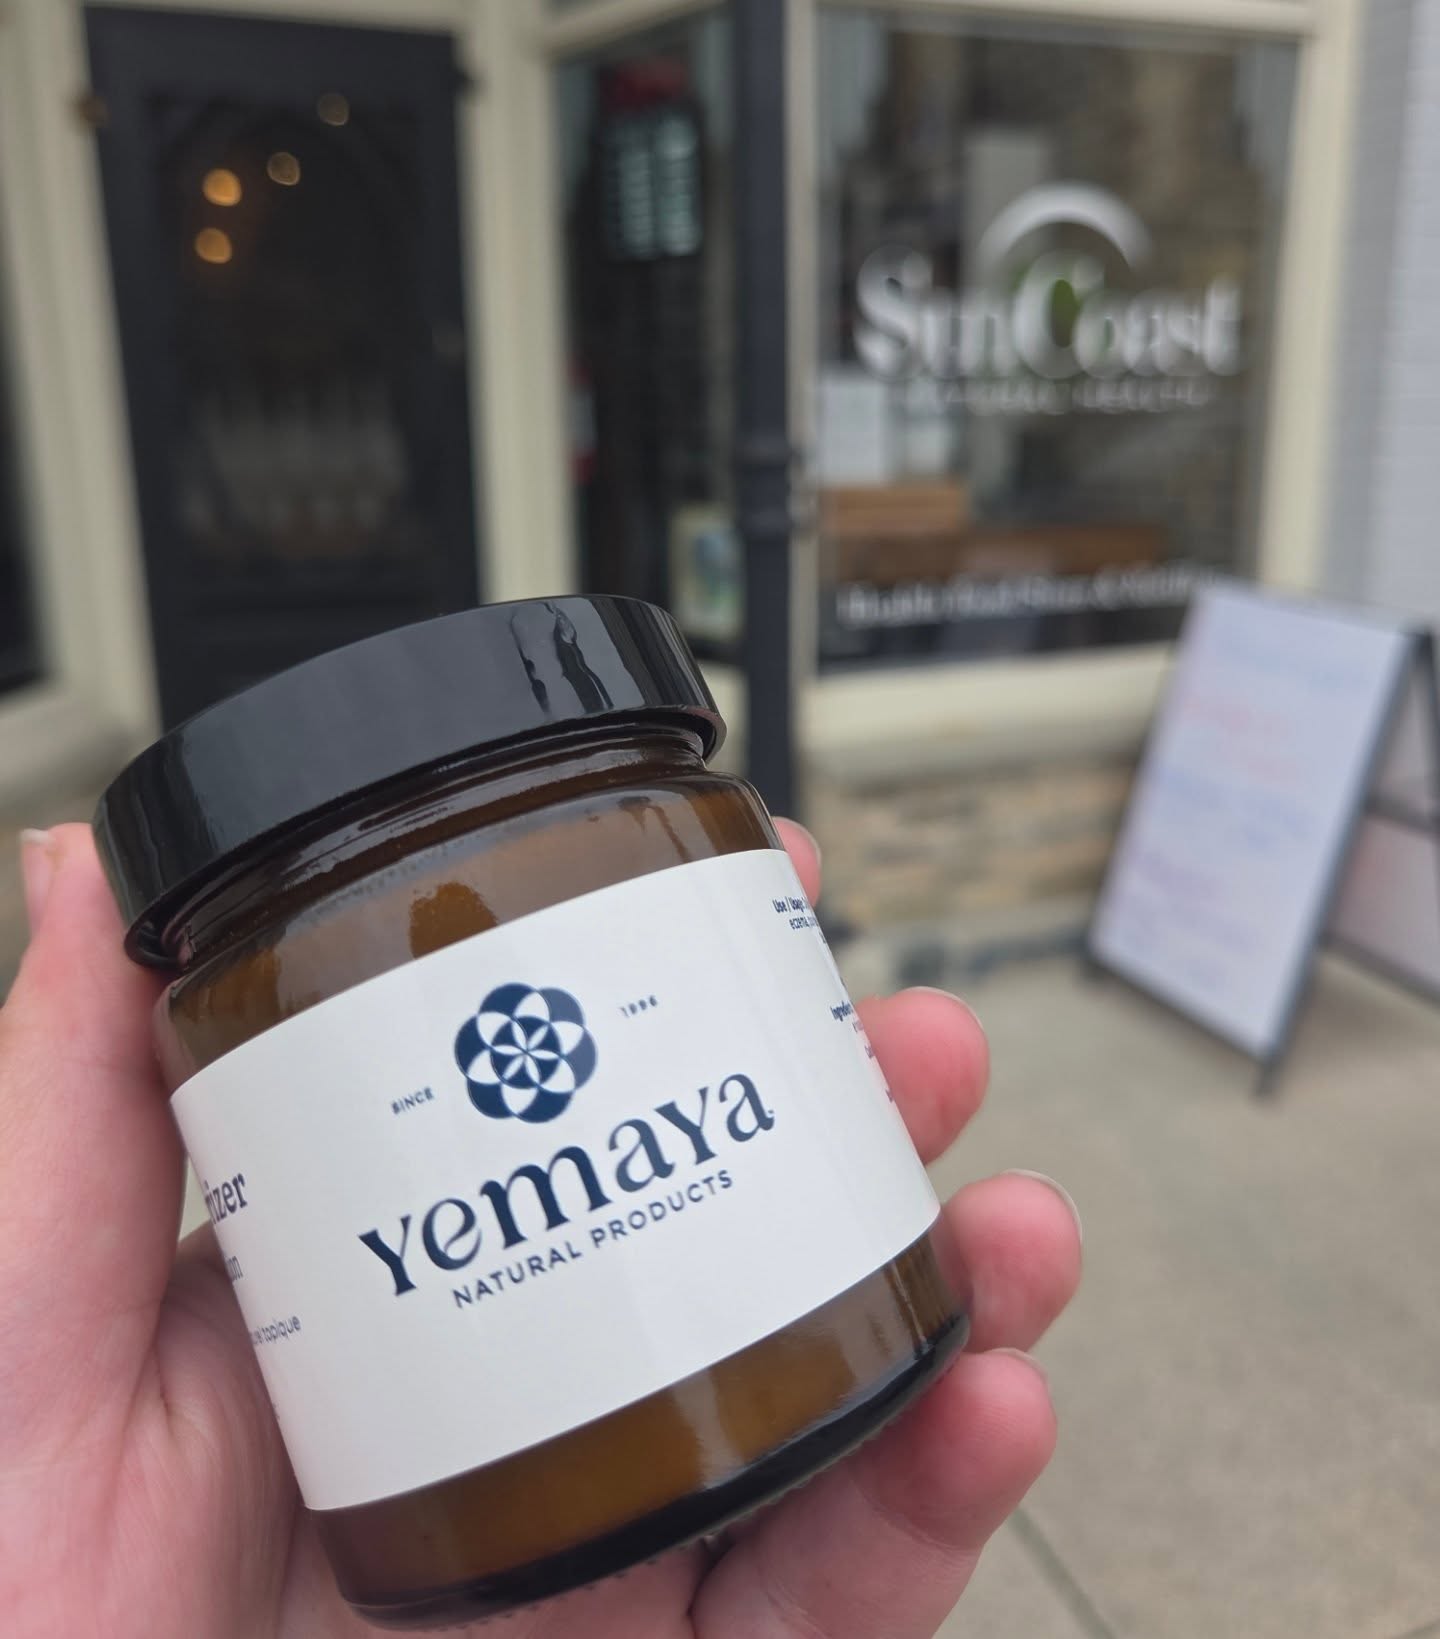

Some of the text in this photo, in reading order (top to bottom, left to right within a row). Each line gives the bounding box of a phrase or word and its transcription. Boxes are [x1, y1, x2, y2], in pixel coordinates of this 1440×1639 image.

[853, 243, 1243, 380] SunCoast
[391, 1087, 434, 1115] SINCE
[452, 1169, 733, 1309] NATURAL PRODUCTS
